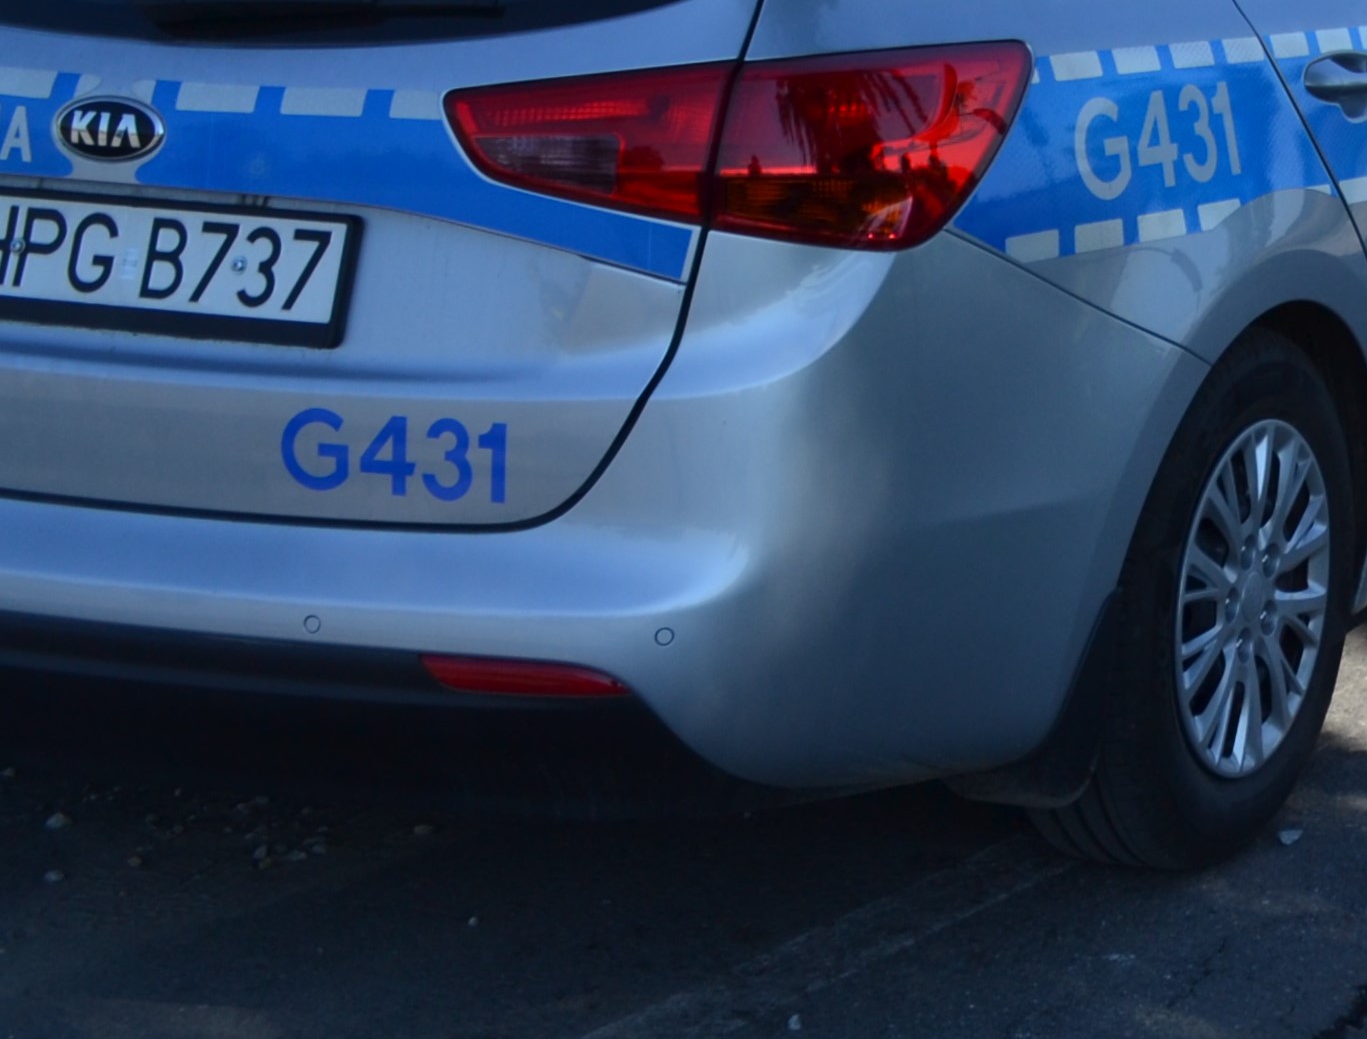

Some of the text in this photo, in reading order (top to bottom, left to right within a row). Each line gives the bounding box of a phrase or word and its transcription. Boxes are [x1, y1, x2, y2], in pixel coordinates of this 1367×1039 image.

[70, 110, 141, 149] KIA
[1074, 81, 1242, 201] G431
[139, 217, 332, 312] B737
[281, 407, 508, 504] G431
